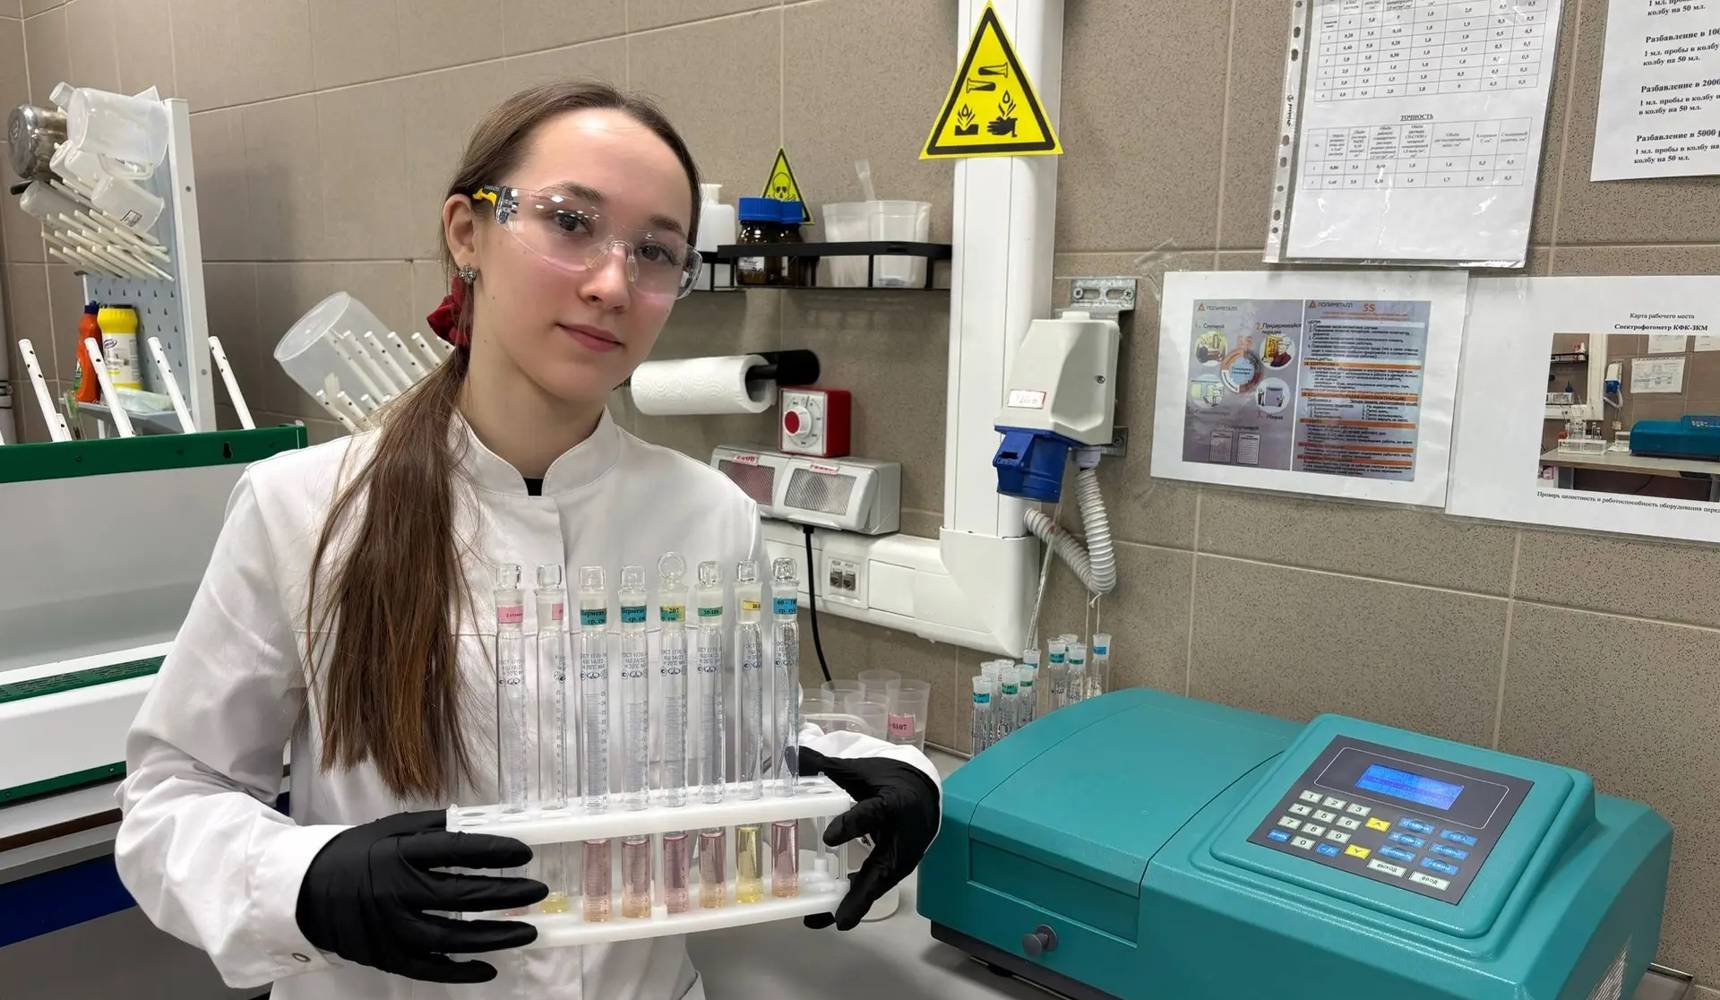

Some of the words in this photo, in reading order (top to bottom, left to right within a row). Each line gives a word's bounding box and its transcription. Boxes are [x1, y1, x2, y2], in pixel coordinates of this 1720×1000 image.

[1648, 7, 1670, 16] колбу
[1646, 32, 1698, 43] Разбавление
[1664, 46, 1688, 55] пробы
[1697, 42, 1719, 52] колбу
[1643, 57, 1665, 66] колбу
[1641, 82, 1692, 93] Разбавление
[1660, 96, 1684, 105] пробы
[1692, 92, 1713, 102] колбу
[1645, 107, 1666, 116] колбу
[1636, 130, 1688, 142] Разбавление
[1697, 129, 1716, 137] 5000
[1655, 144, 1679, 154] пробы
[1687, 142, 1709, 151] колбу
[1634, 156, 1655, 164] колбу
[1649, 312, 1677, 320] рабочего
[1614, 324, 1672, 332] Спектрофотометр
[1537, 491, 1560, 500] Проверь
[1602, 498, 1658, 508] работоспособность
[1660, 502, 1702, 512] оборудования
